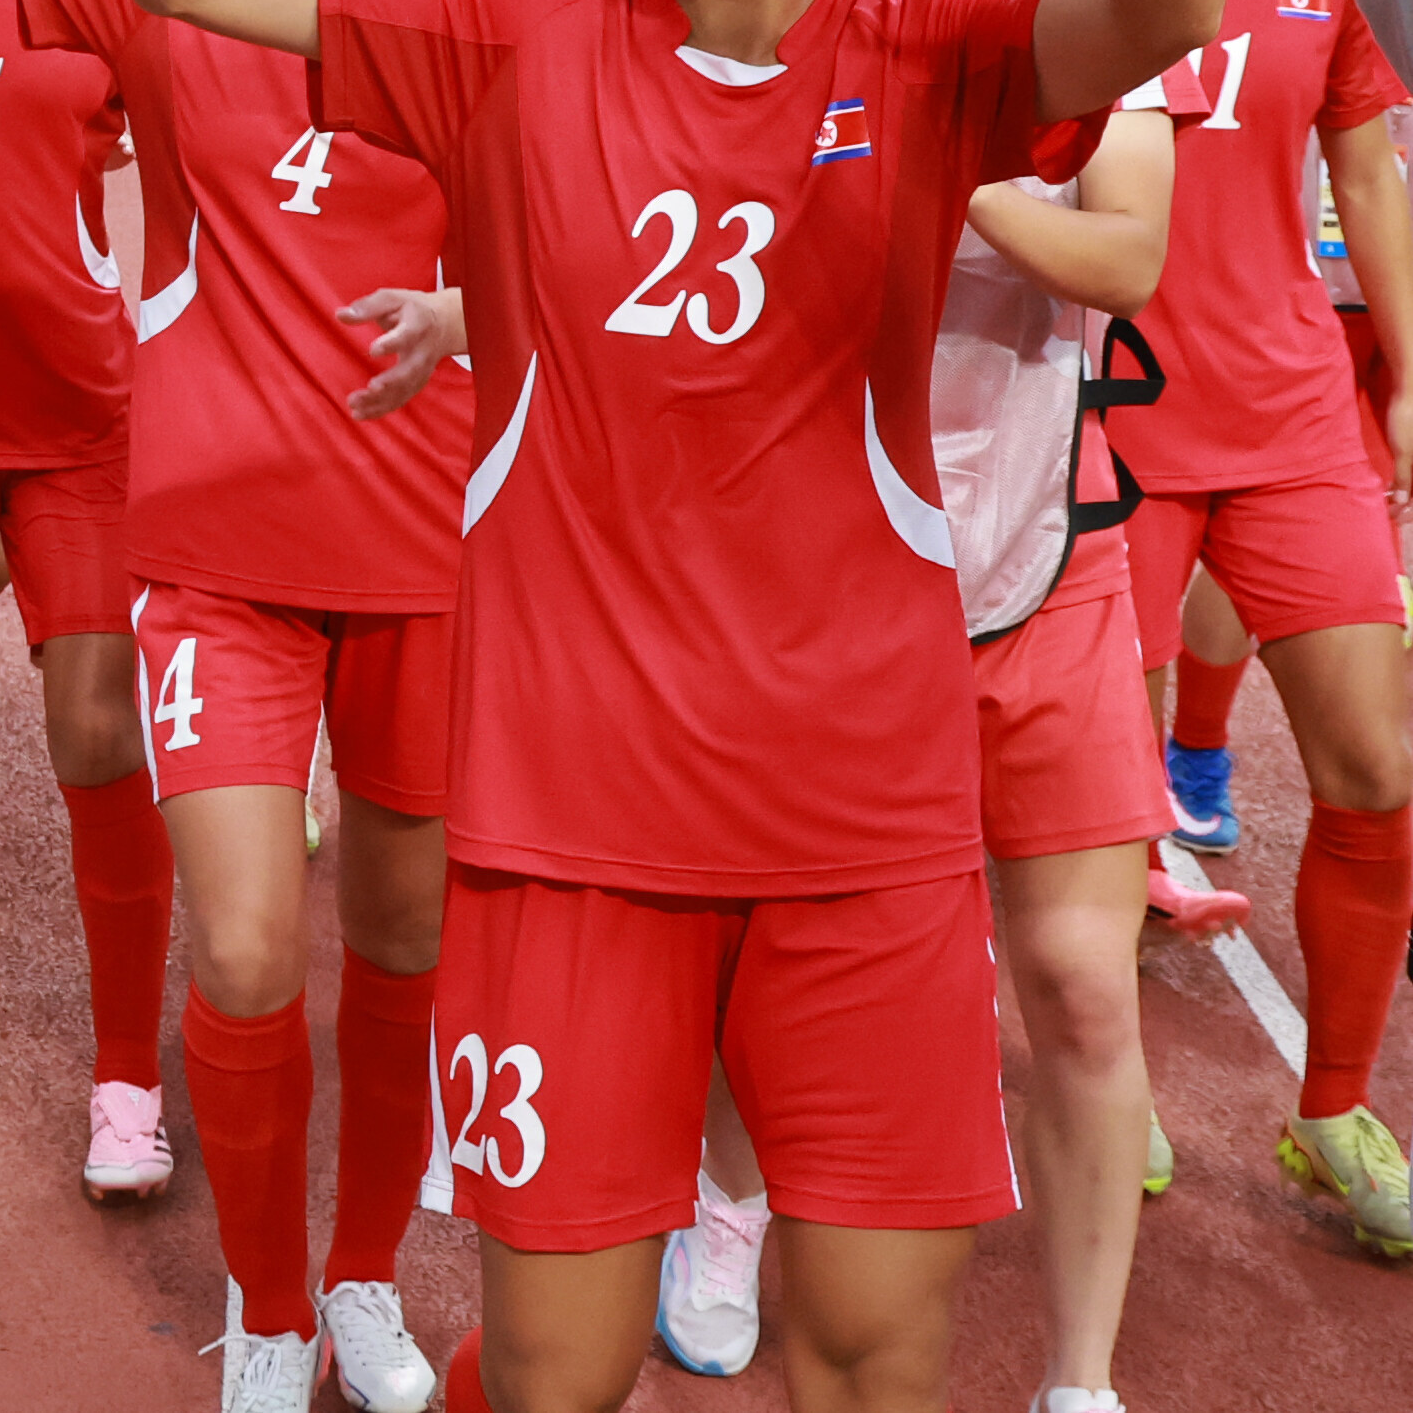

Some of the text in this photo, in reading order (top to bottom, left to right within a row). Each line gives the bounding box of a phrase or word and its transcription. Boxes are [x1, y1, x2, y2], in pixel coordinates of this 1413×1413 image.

[271, 127, 333, 215] 4
[604, 189, 775, 345] 23
[154, 637, 204, 752] 4
[449, 1033, 547, 1188] 23
